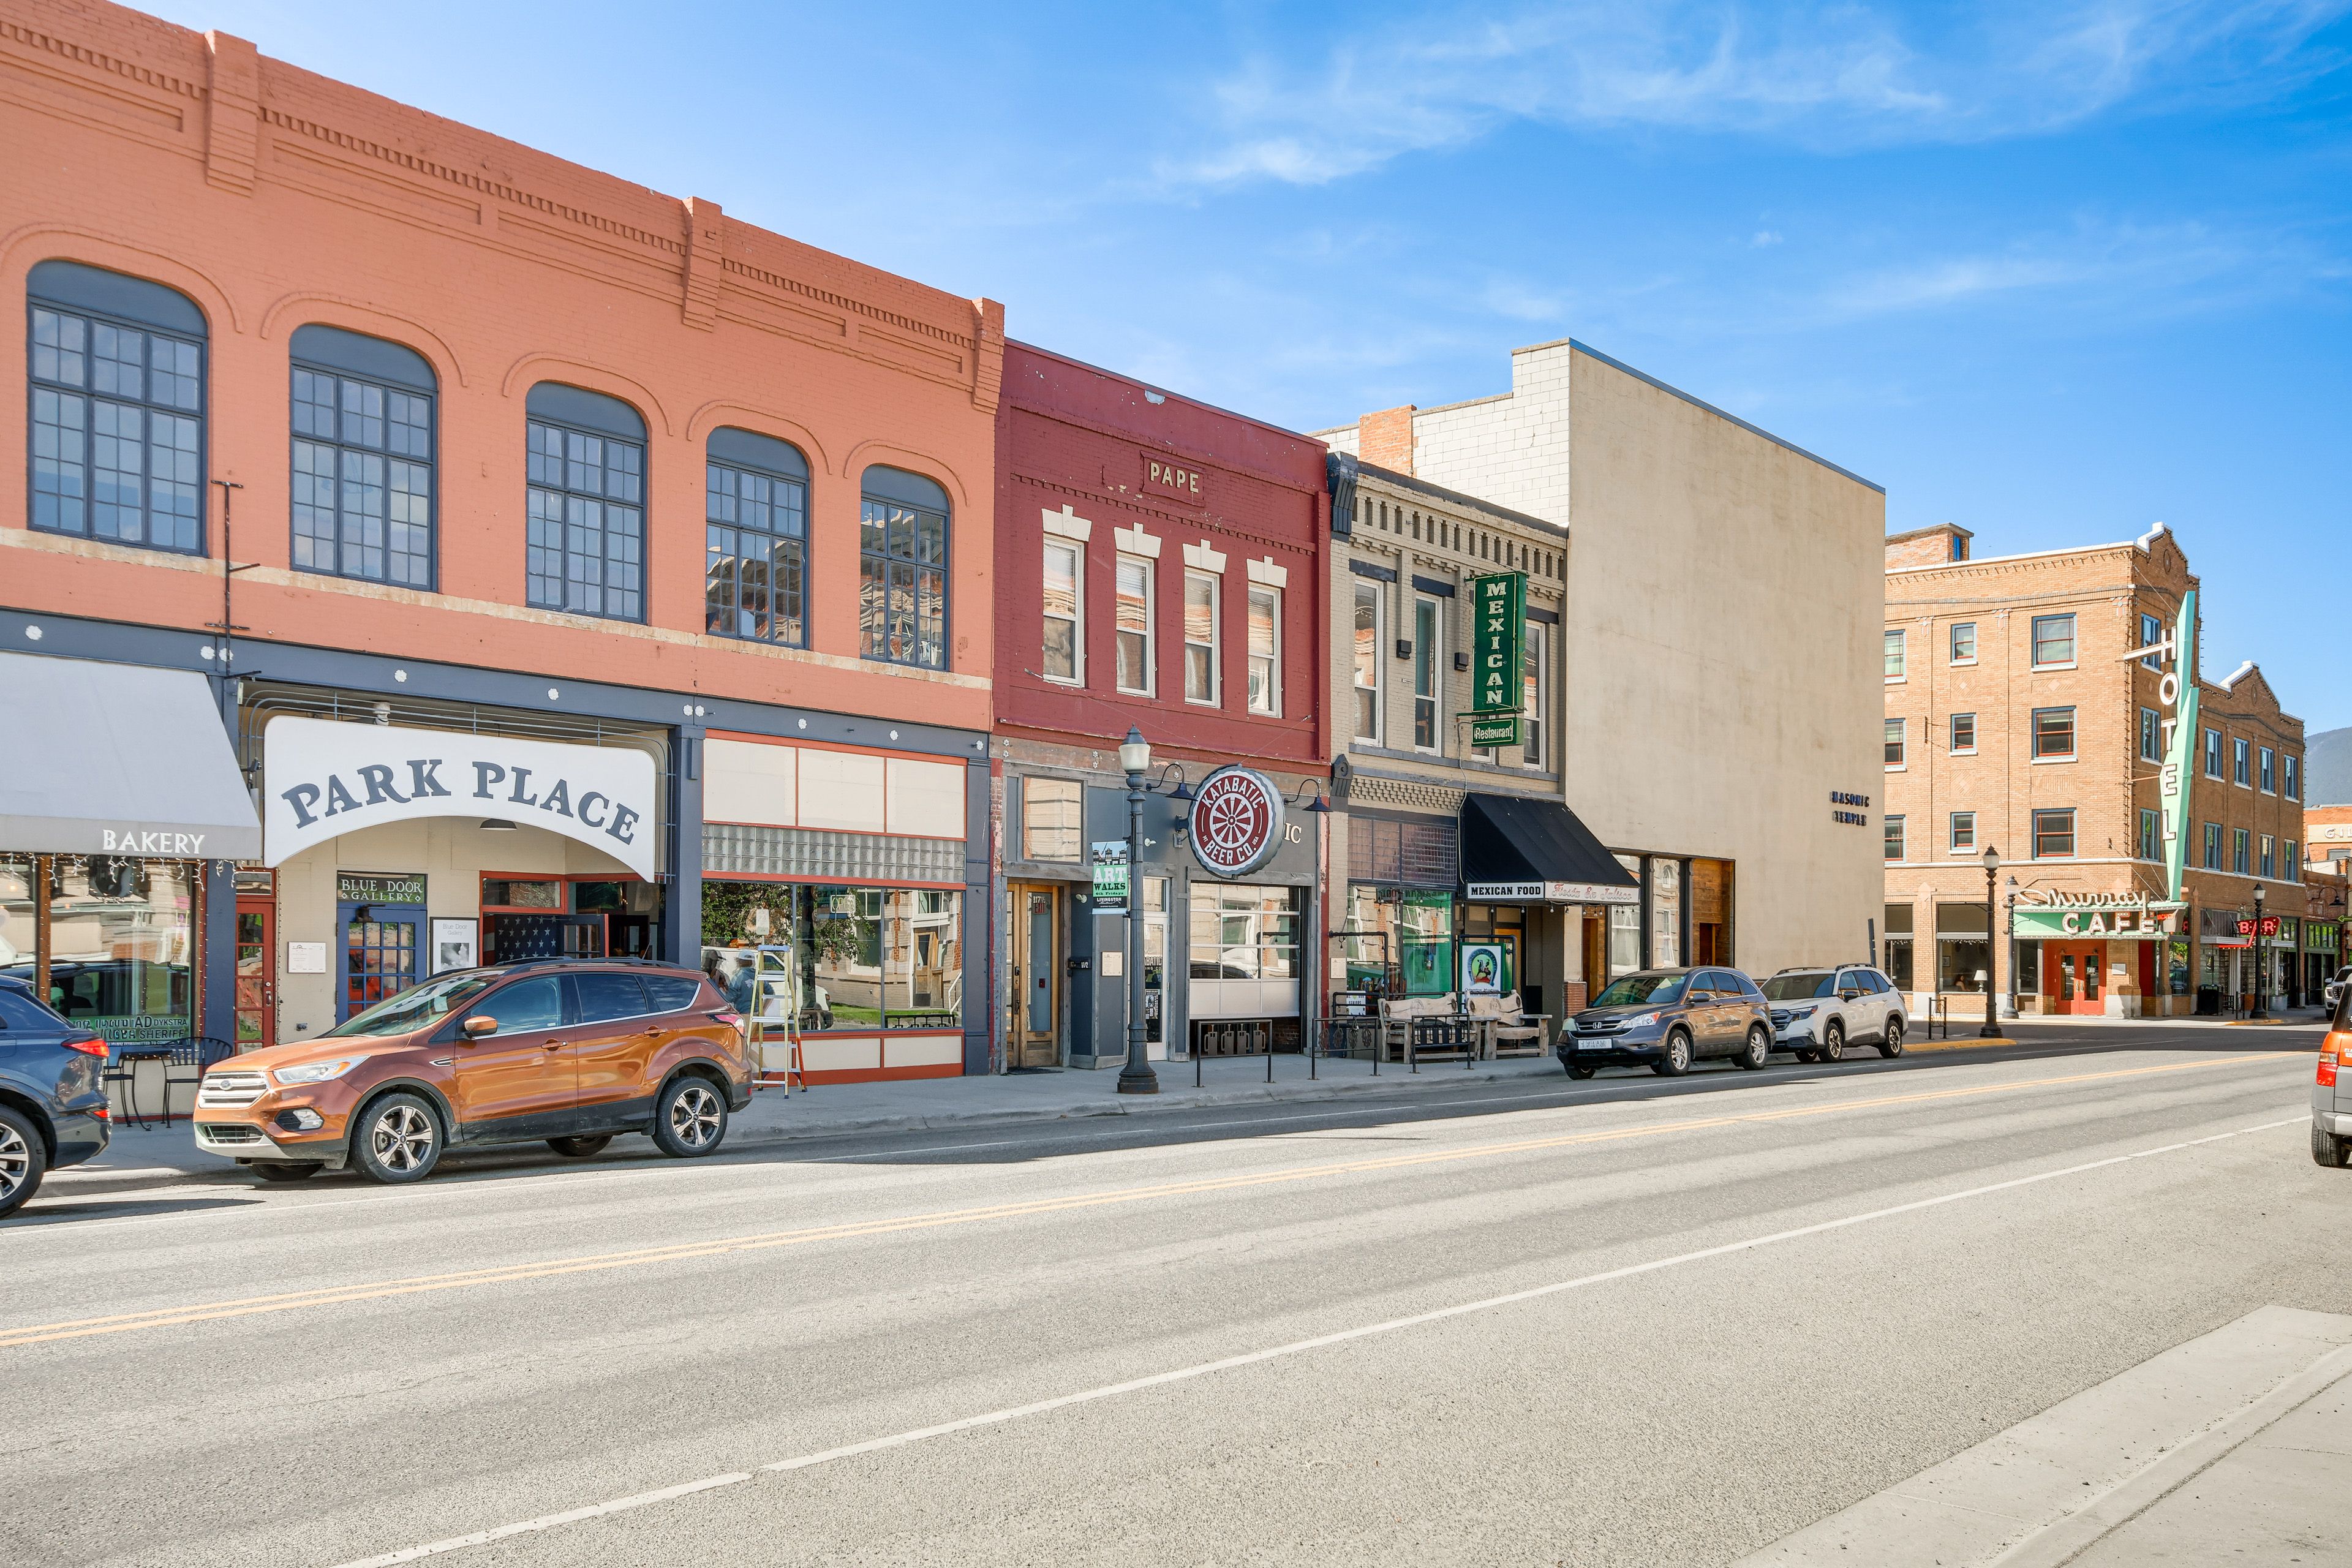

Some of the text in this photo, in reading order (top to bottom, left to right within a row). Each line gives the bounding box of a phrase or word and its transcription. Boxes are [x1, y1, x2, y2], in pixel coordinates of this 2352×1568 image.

[1150, 462, 1199, 493] PAPE
[1486, 582, 1507, 704] MEXICAN
[1474, 725, 1513, 740] Restaurant
[2159, 625, 2179, 840] HOTEL
[1201, 777, 1265, 809] KATABATIC
[1830, 791, 1869, 807] MASONIC
[281, 759, 640, 846] PARK PLACE
[1833, 810, 1867, 826] TEMPLE
[103, 829, 205, 854] BAKERY
[1204, 840, 1257, 864] BEER CO.
[1093, 867, 1126, 883] ART
[341, 879, 423, 892] BLUE DOOR
[1471, 886, 1541, 895] MEXICAN FOOD
[351, 891, 412, 902] GALLERY
[2018, 888, 2150, 916] Murray
[2240, 921, 2274, 933] BR
[139, 1029, 185, 1039] SHERIFF
